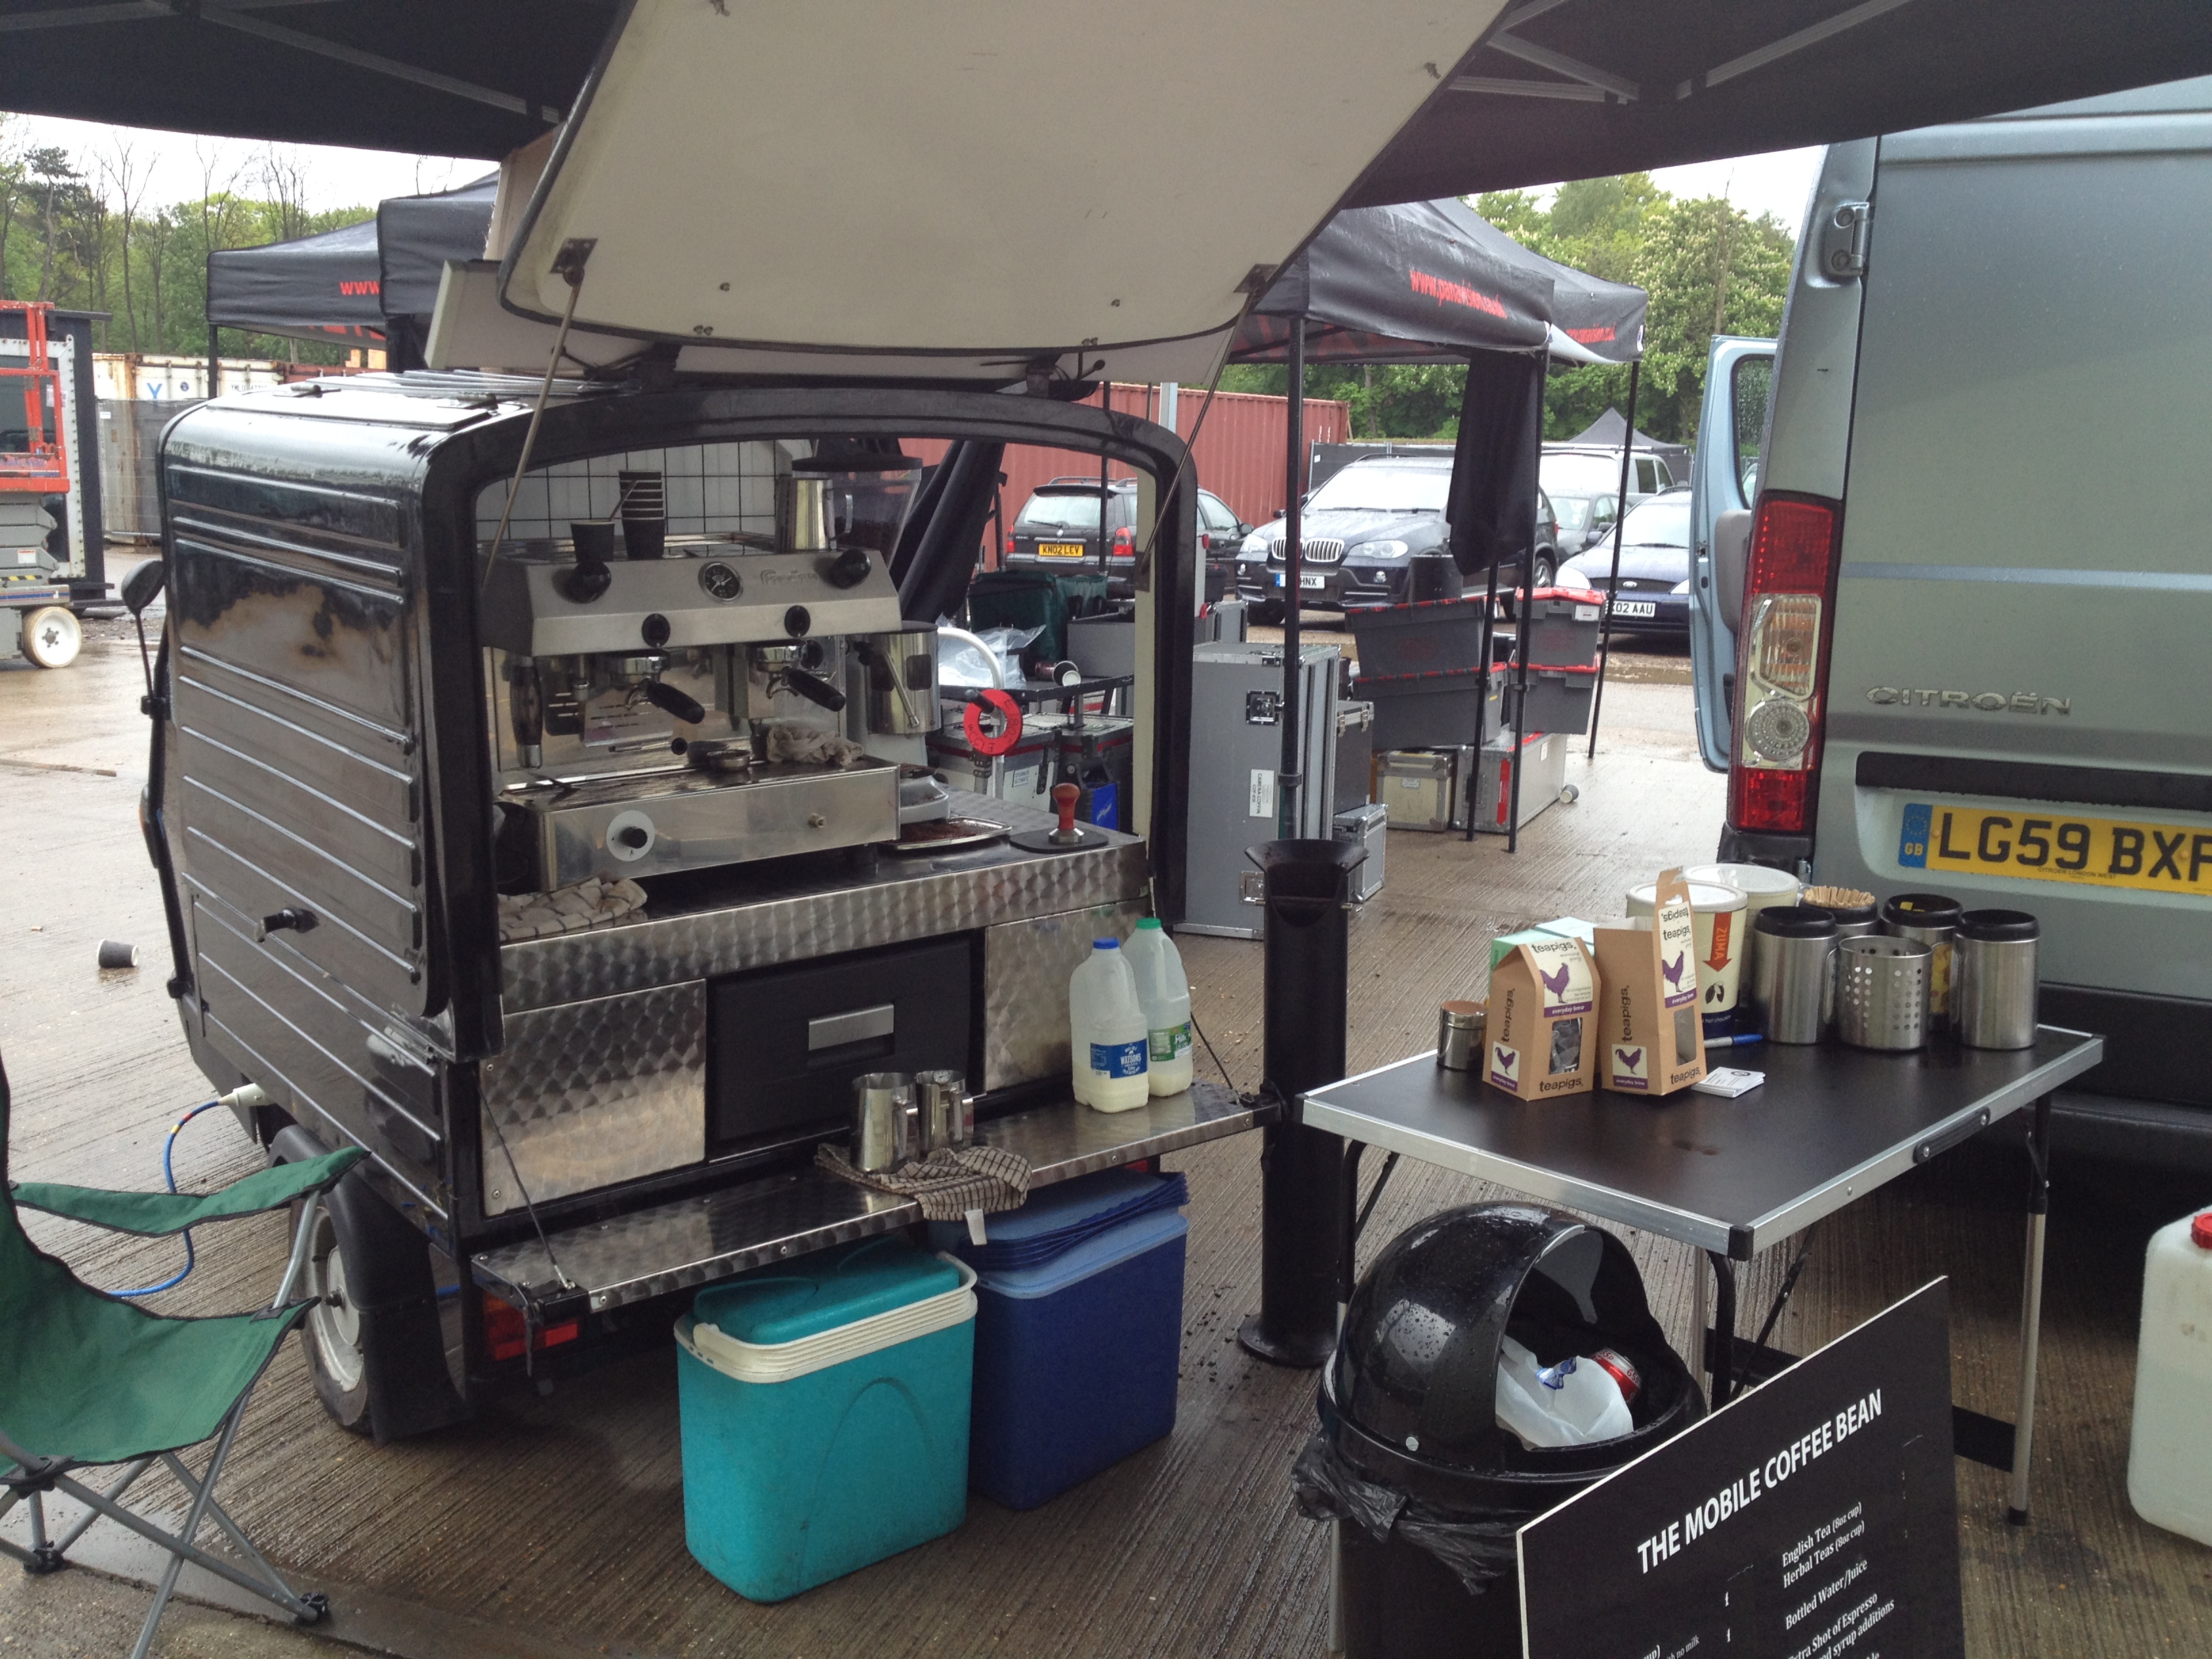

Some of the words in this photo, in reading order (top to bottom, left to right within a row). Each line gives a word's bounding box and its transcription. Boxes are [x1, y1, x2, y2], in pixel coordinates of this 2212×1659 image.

[1042, 544, 1063, 555] KN02
[1632, 603, 1653, 615] AAU
[1865, 684, 2071, 715] CITROËN
[1904, 842, 1924, 857] GB
[1938, 813, 2091, 871] LG59
[1714, 926, 1727, 960] ZUMA
[1552, 1006, 1573, 1015] everyday
[1637, 1521, 1681, 1574] THE
[1685, 1467, 1761, 1545] MOBILE
[1764, 1420, 1833, 1489] COFFEE
[1836, 1387, 1882, 1443] BEAN
[1782, 1534, 1814, 1568] English
[1814, 1524, 1831, 1543] Tea
[1832, 1514, 1847, 1534] (8oz
[1847, 1501, 1862, 1521] cup)
[1783, 1555, 1814, 1589] Herbal
[1814, 1542, 1835, 1565] Teas
[1835, 1533, 1850, 1553] (8oz
[1850, 1519, 1865, 1539] cup)
[1785, 1594, 1818, 1631] Bottled
[1818, 1559, 1868, 1605] Water/Juice
[1685, 1635, 1700, 1653] milk
[1788, 1645, 1811, 1659] tra
[1812, 1627, 1832, 1653] Shot
[1832, 1616, 1843, 1636] of
[1842, 1593, 1879, 1630] Espresso
[1832, 1629, 1857, 1658] syrup
[1857, 1599, 1896, 1637] additions
